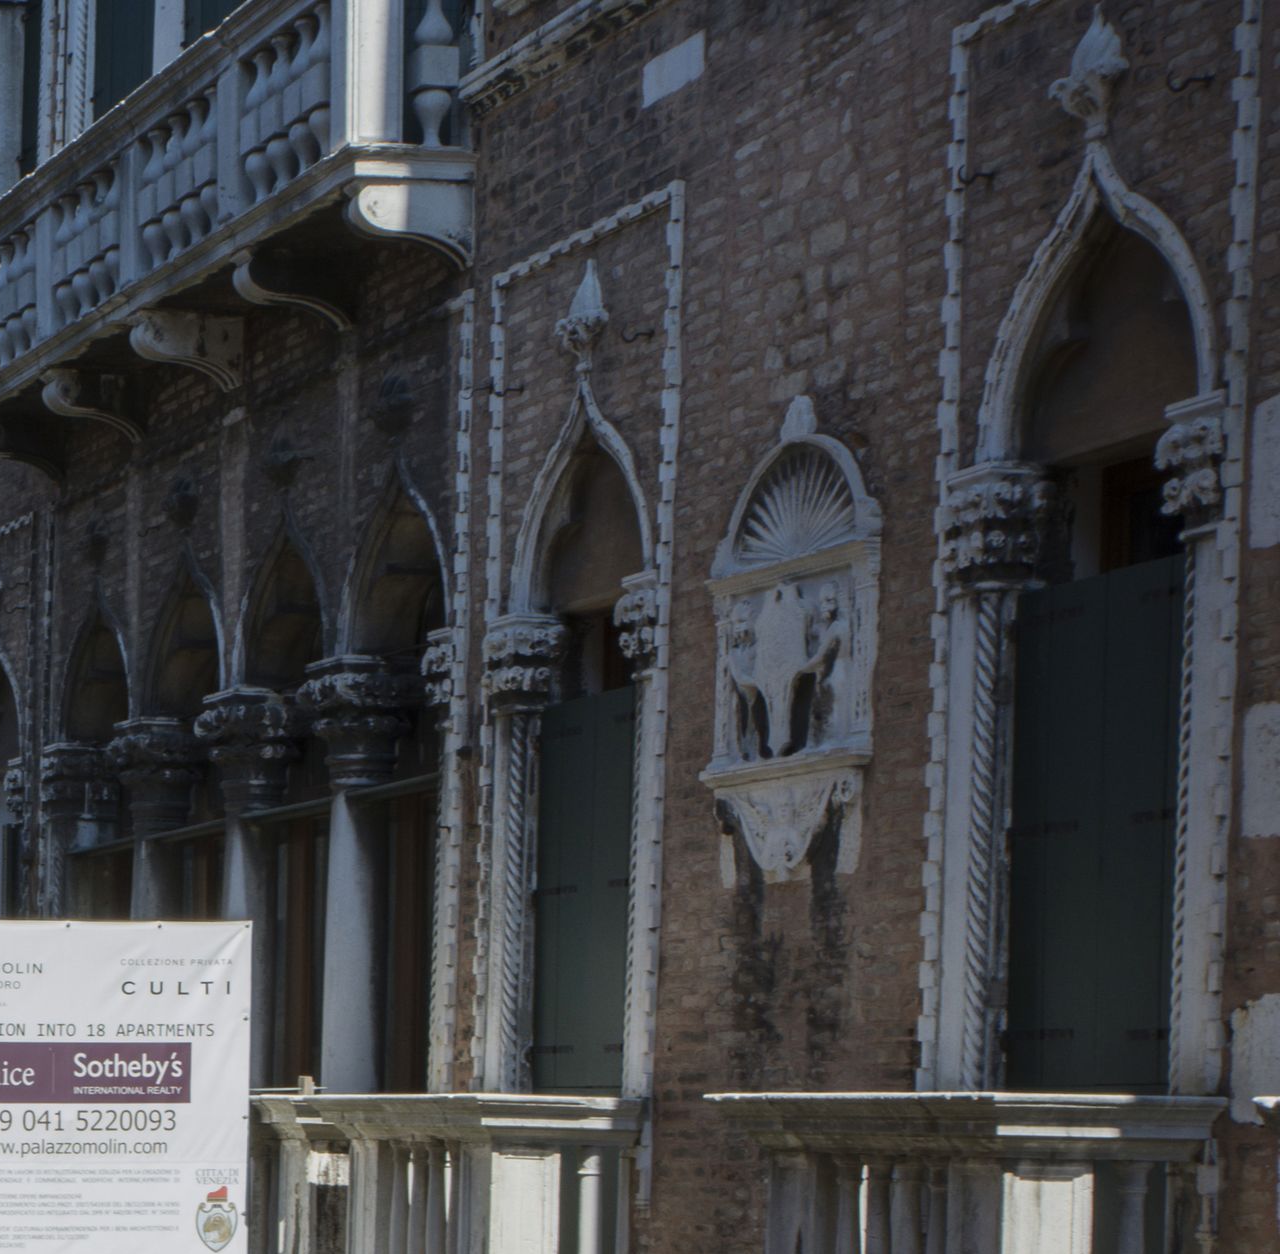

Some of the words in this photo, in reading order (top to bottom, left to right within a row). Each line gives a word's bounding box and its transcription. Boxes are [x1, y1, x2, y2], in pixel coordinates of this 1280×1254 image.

[119, 958, 186, 966] COLLEZIONE
[190, 958, 233, 966] PRIVATA
[121, 980, 232, 996] CULTI
[37, 1023, 77, 1038] INTO
[87, 1023, 106, 1038] 18
[115, 1023, 215, 1038] APARTMENTS
[73, 1052, 183, 1084] Sotheby's
[73, 1086, 145, 1095] INTERNATIONAL
[147, 1086, 182, 1095] REALTY
[22, 1109, 65, 1132] 041
[75, 1109, 177, 1132] 5220093
[195, 1176, 240, 1185] VENEZIA
